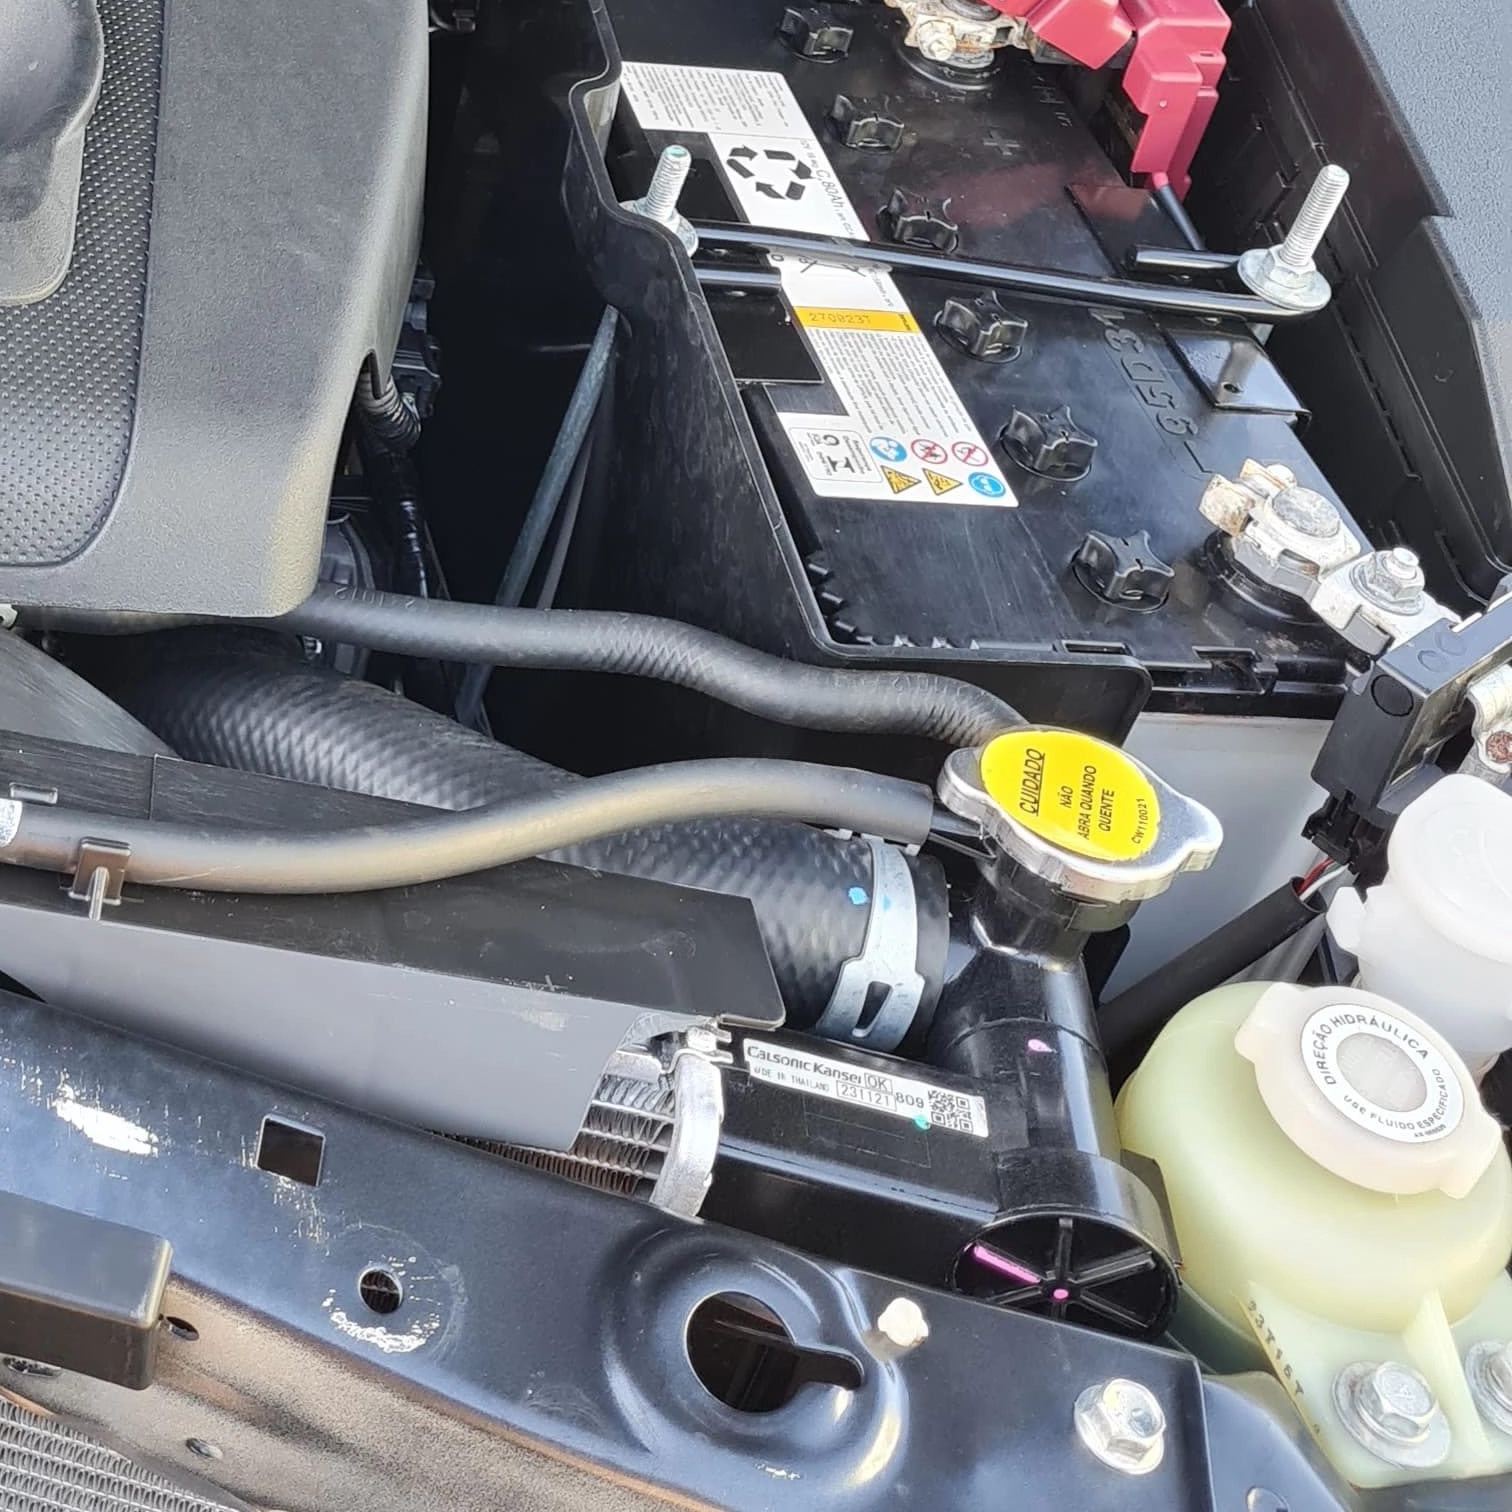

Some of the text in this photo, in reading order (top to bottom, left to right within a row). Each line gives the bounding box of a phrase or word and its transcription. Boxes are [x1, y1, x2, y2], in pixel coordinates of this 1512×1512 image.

[1019, 748, 1044, 815] CUIDADO
[1058, 785, 1073, 808] NÃO
[1077, 766, 1097, 840] ABRA QUANDO
[1098, 789, 1115, 832] QUENTE
[1312, 1014, 1429, 1085] DIREÇÃO HIDRÁULICA
[813, 1062, 862, 1084] Kansei
[867, 1076, 887, 1090] OK
[841, 1084, 891, 1107] 231121
[895, 1091, 925, 1109] 809
[1370, 1112, 1415, 1130] FLUIDO
[1417, 1068, 1449, 1129] ESPECIFICADO
